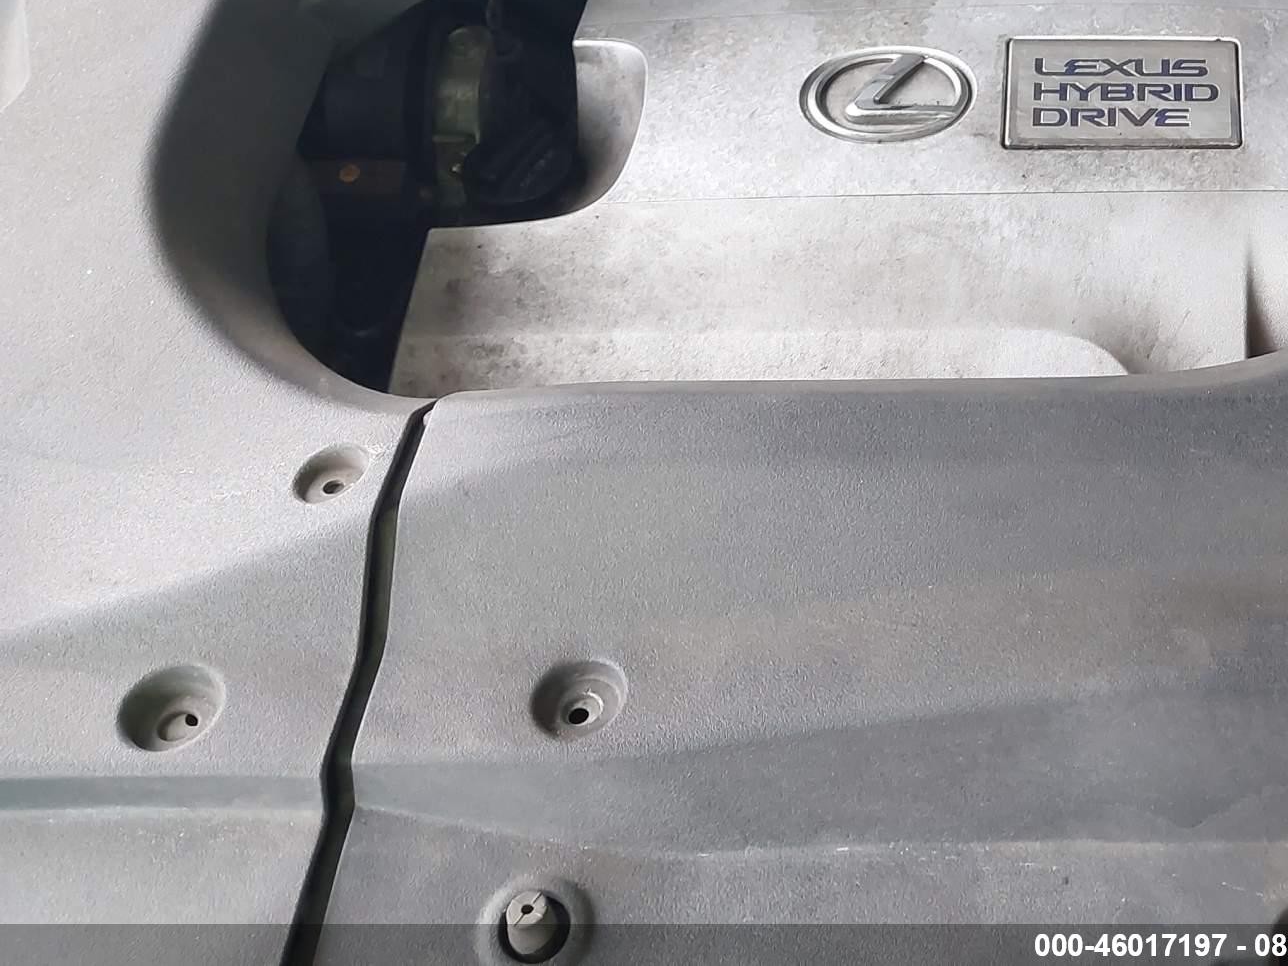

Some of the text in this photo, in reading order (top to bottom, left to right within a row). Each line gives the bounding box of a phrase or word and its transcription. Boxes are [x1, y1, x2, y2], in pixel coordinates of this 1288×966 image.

[1033, 57, 1209, 78] LEXUS
[1033, 81, 1220, 102] HYBRID
[1032, 106, 1191, 128] DRIVE
